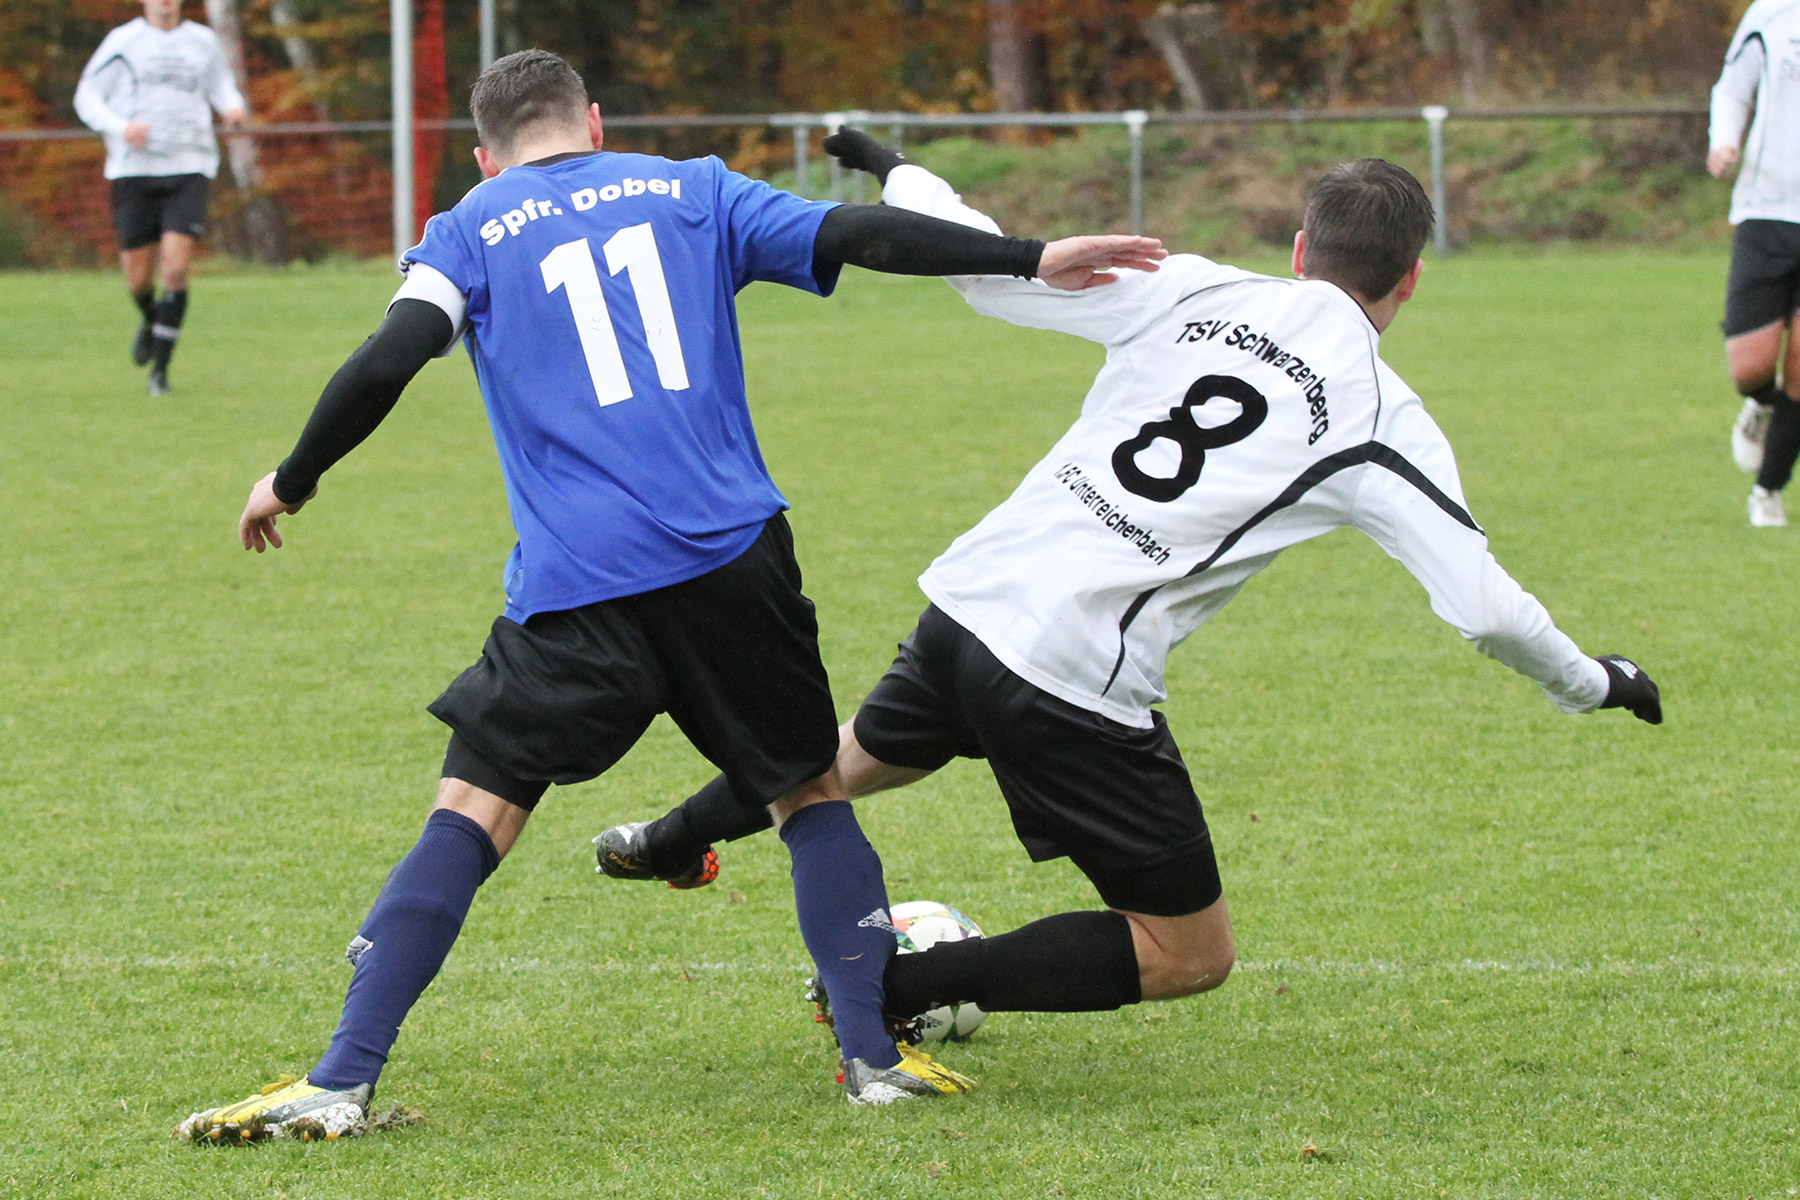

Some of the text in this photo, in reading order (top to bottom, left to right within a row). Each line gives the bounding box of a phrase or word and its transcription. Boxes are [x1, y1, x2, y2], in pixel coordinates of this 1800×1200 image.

[480, 177, 681, 246] Spfr. Dobel
[539, 222, 690, 407] 11
[1111, 374, 1268, 503] 8
[1175, 320, 1329, 446] TSV Schwarzenberg
[1070, 476, 1171, 566] Unterreichenbach
